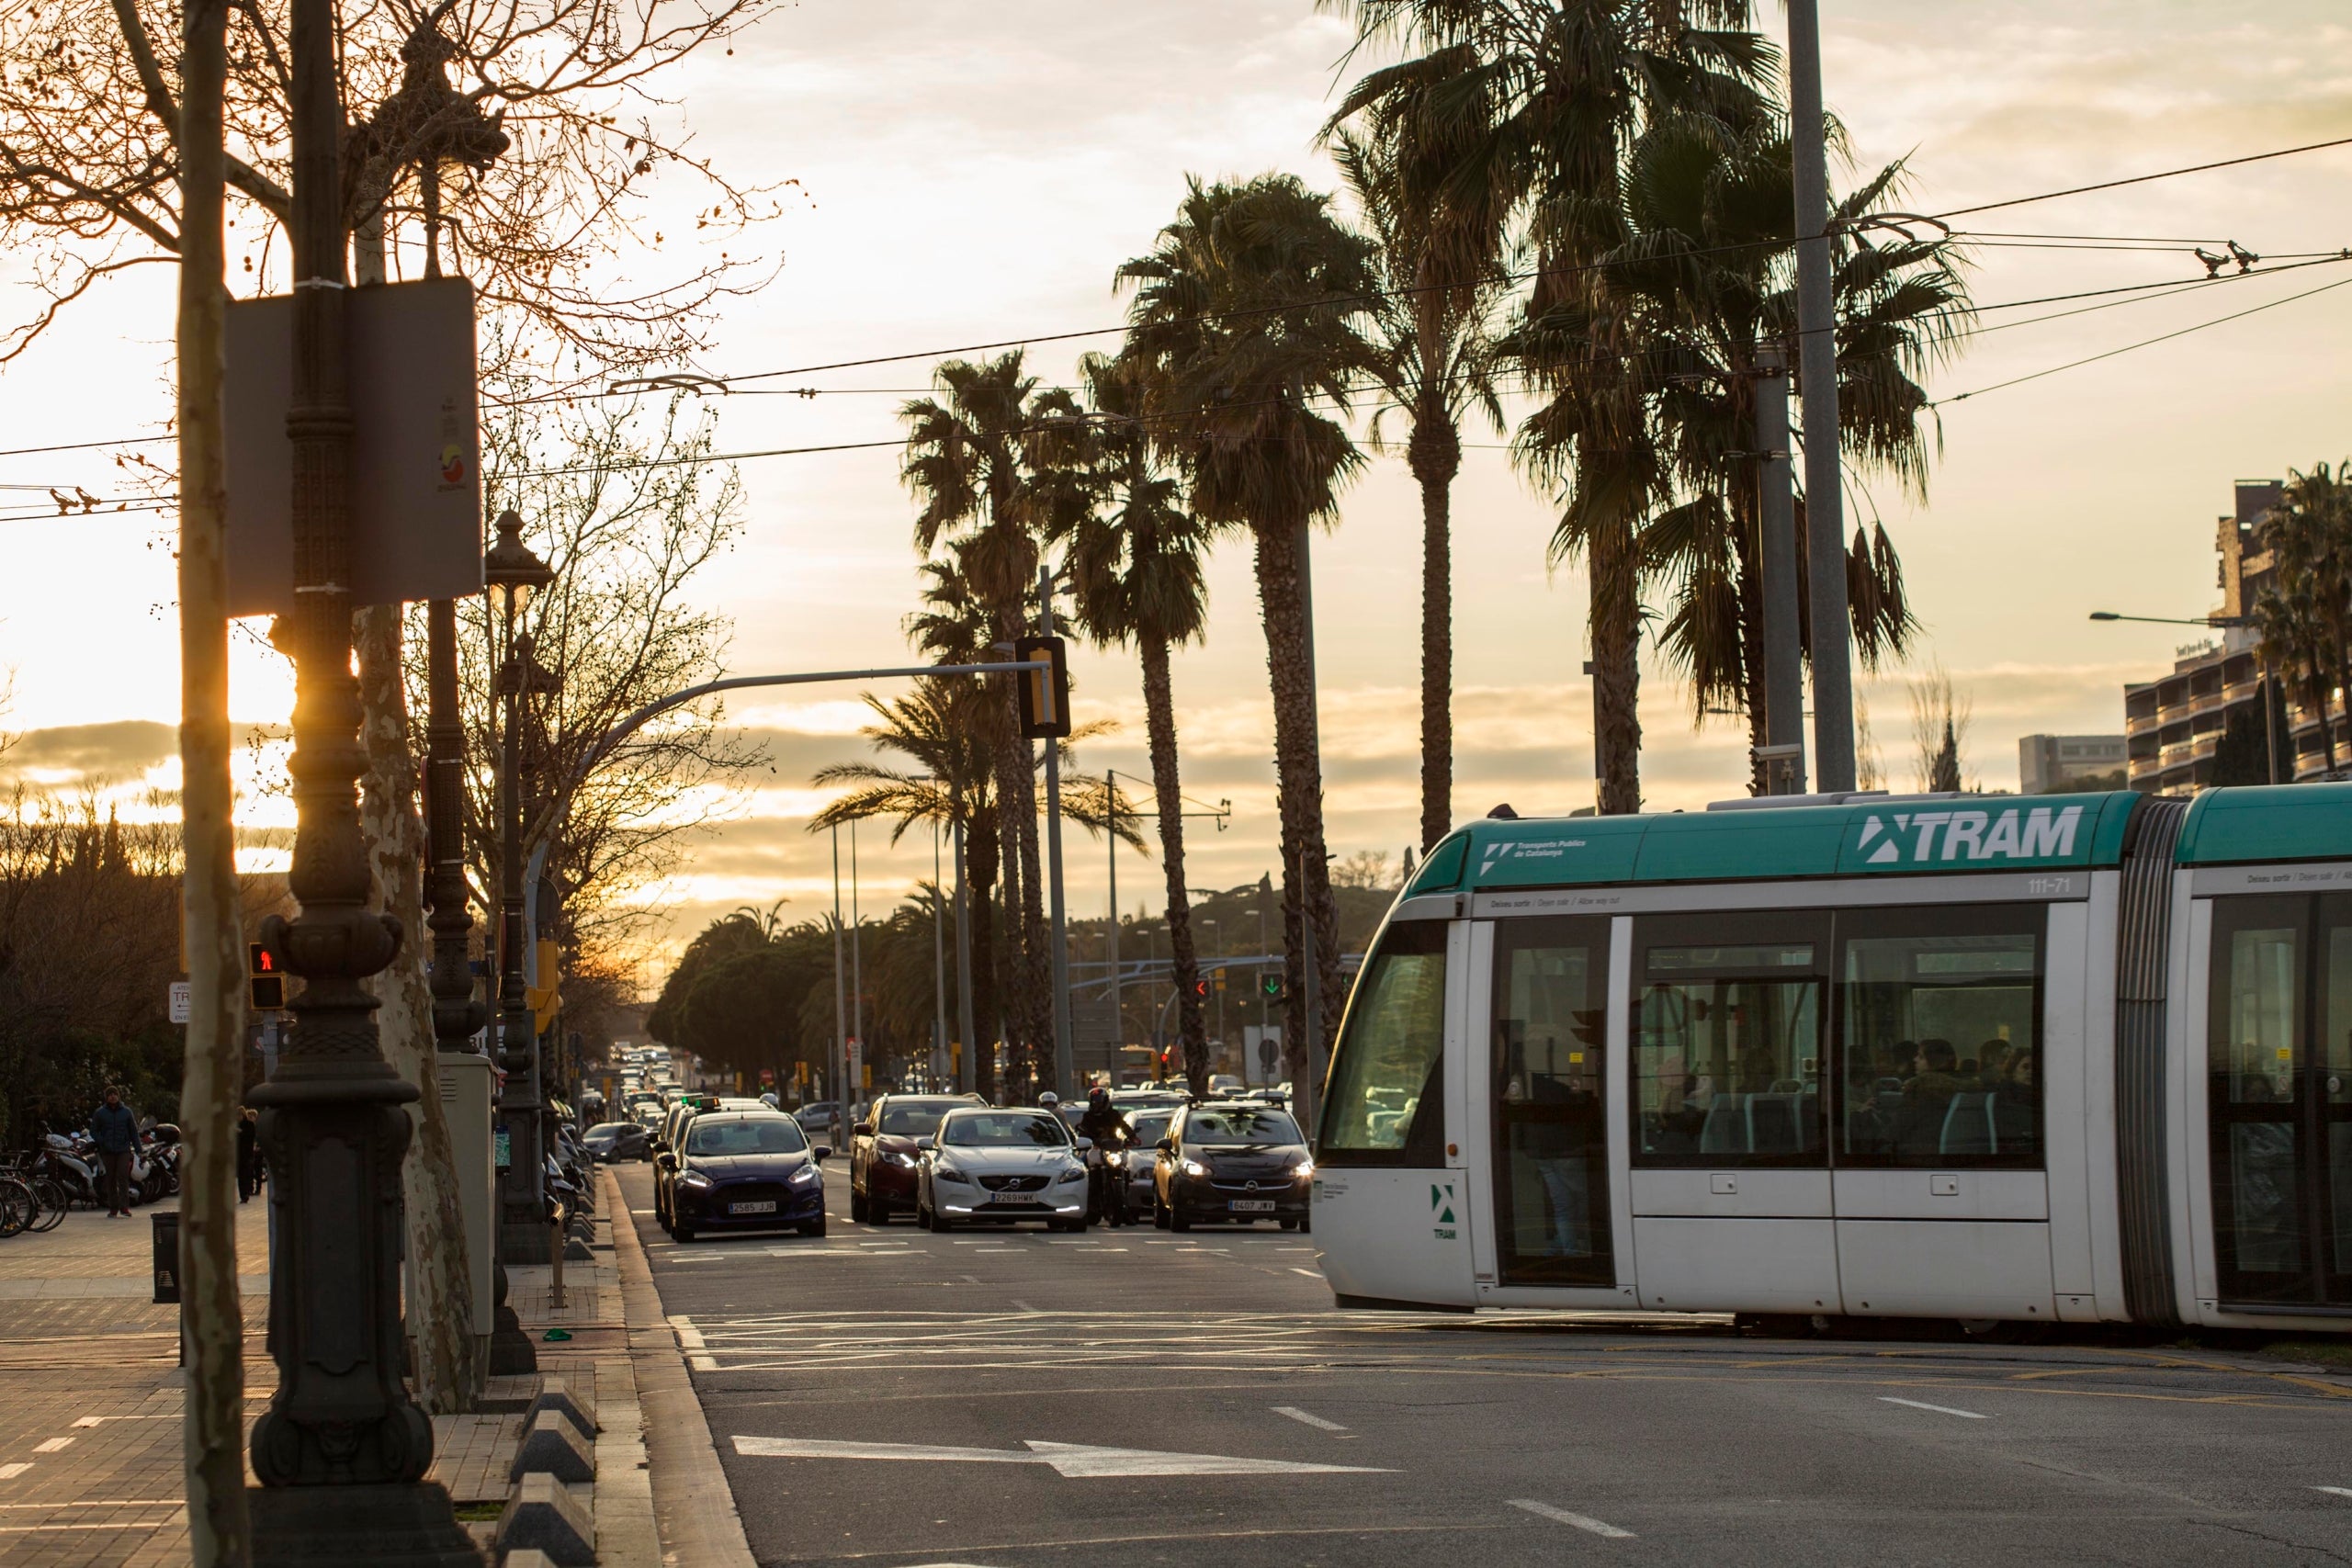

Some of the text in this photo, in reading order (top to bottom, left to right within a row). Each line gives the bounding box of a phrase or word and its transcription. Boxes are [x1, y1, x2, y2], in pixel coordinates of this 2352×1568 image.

[1911, 806, 2084, 862] TRAM
[173, 992, 190, 1001] TR
[1433, 1228, 1456, 1240] TRAM
